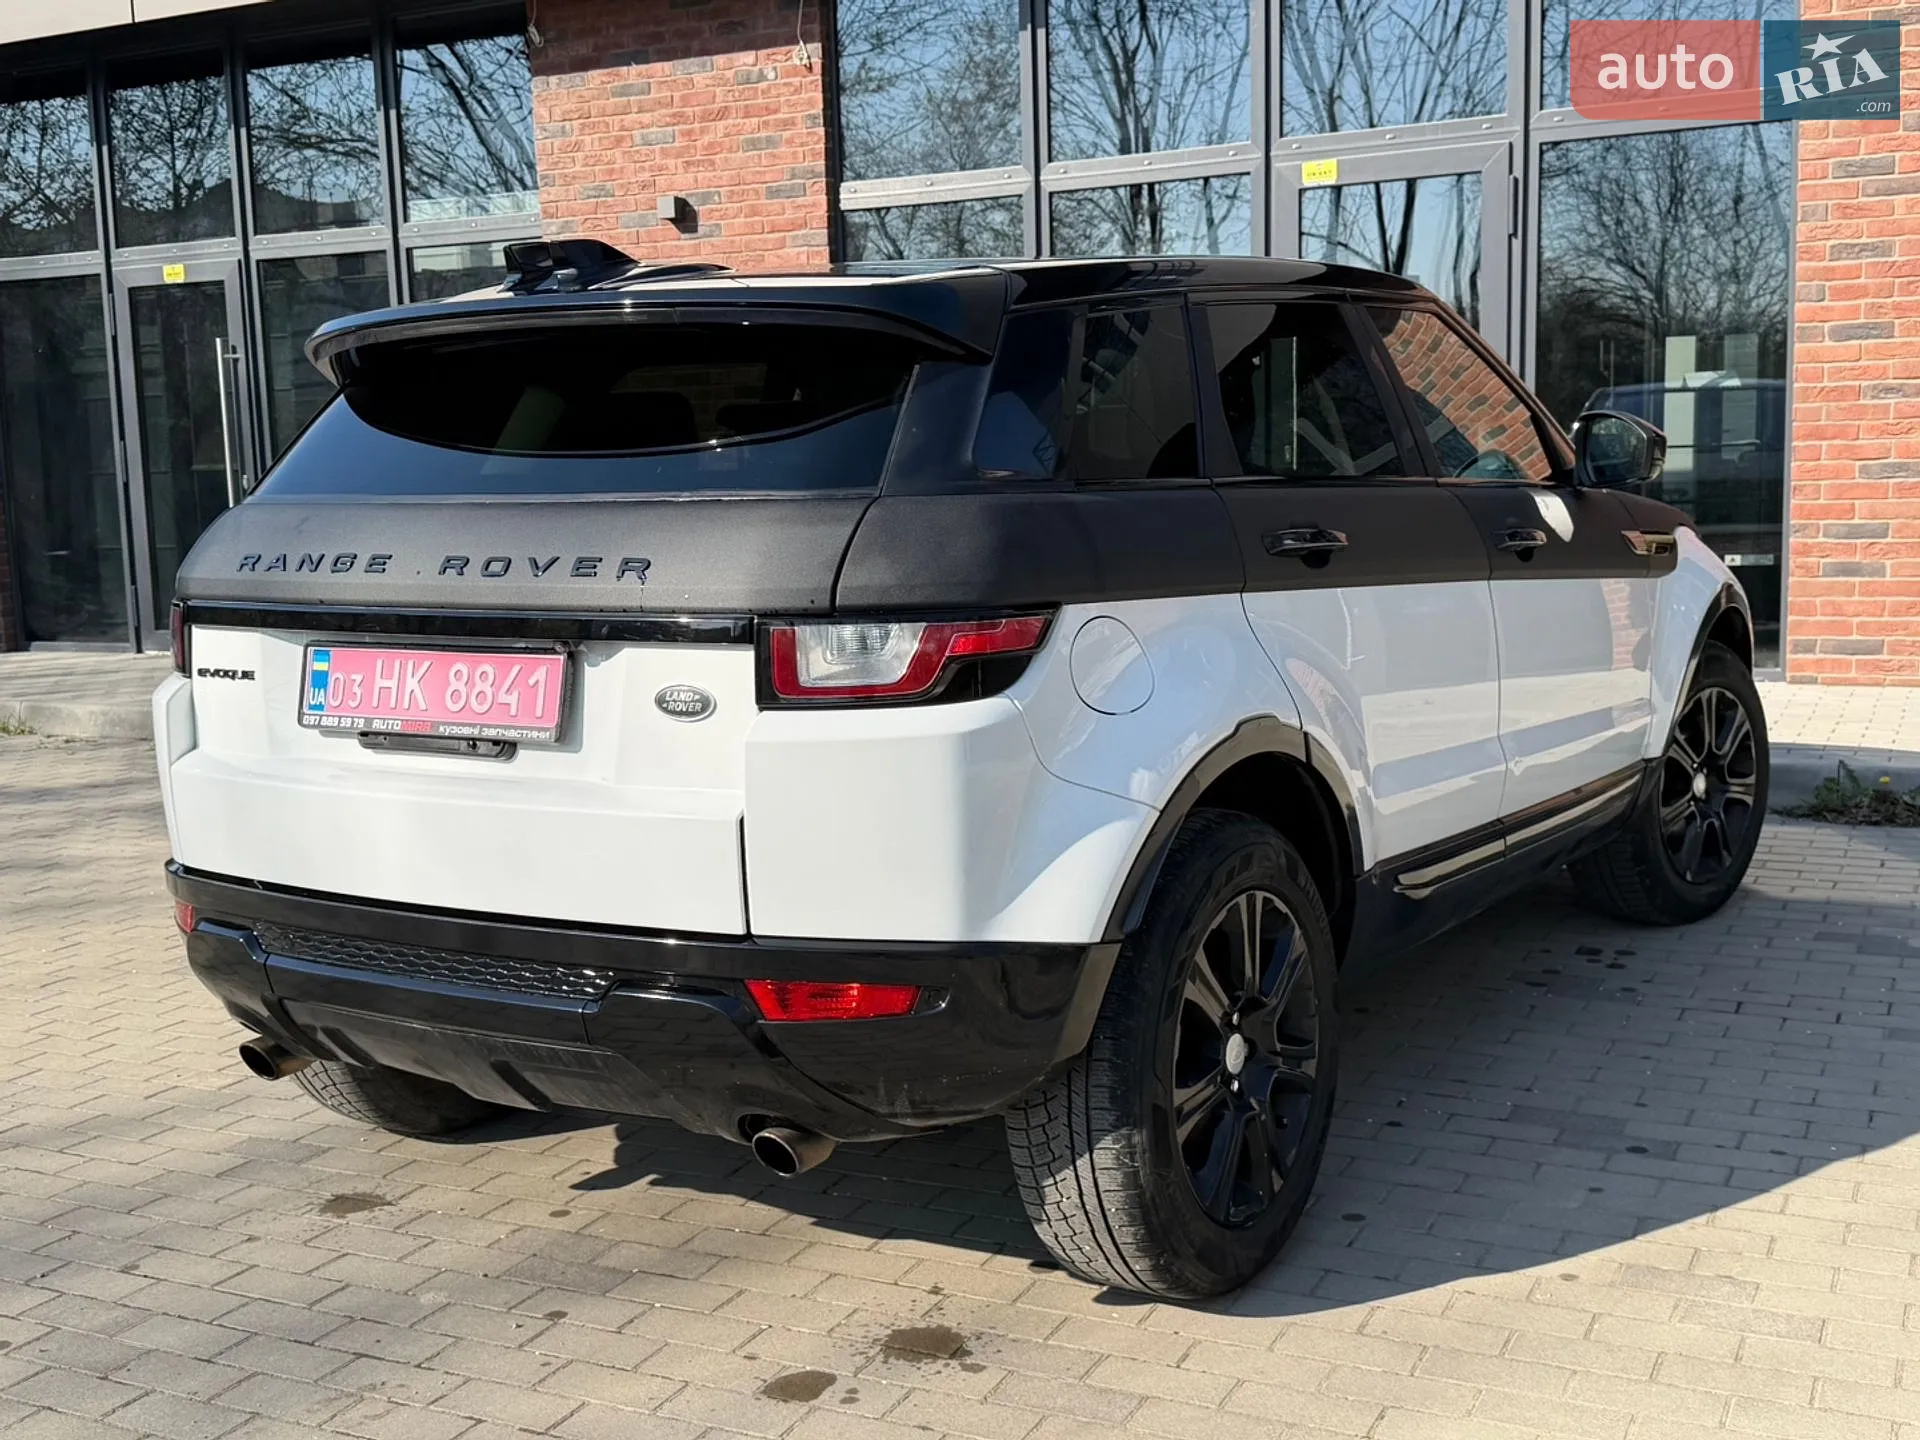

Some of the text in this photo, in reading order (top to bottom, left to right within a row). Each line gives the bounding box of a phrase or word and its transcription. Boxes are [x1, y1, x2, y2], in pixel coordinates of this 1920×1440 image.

[237, 553, 652, 581] RANGE ROVER
[197, 668, 256, 680] EVOQUE
[328, 657, 549, 718] 03 HK 8841
[309, 688, 326, 706] UA
[665, 690, 694, 702] LAND
[667, 701, 703, 713] ROVER
[302, 714, 320, 726] 097
[320, 716, 339, 727] 889
[438, 724, 551, 741] кузовні запчастини
